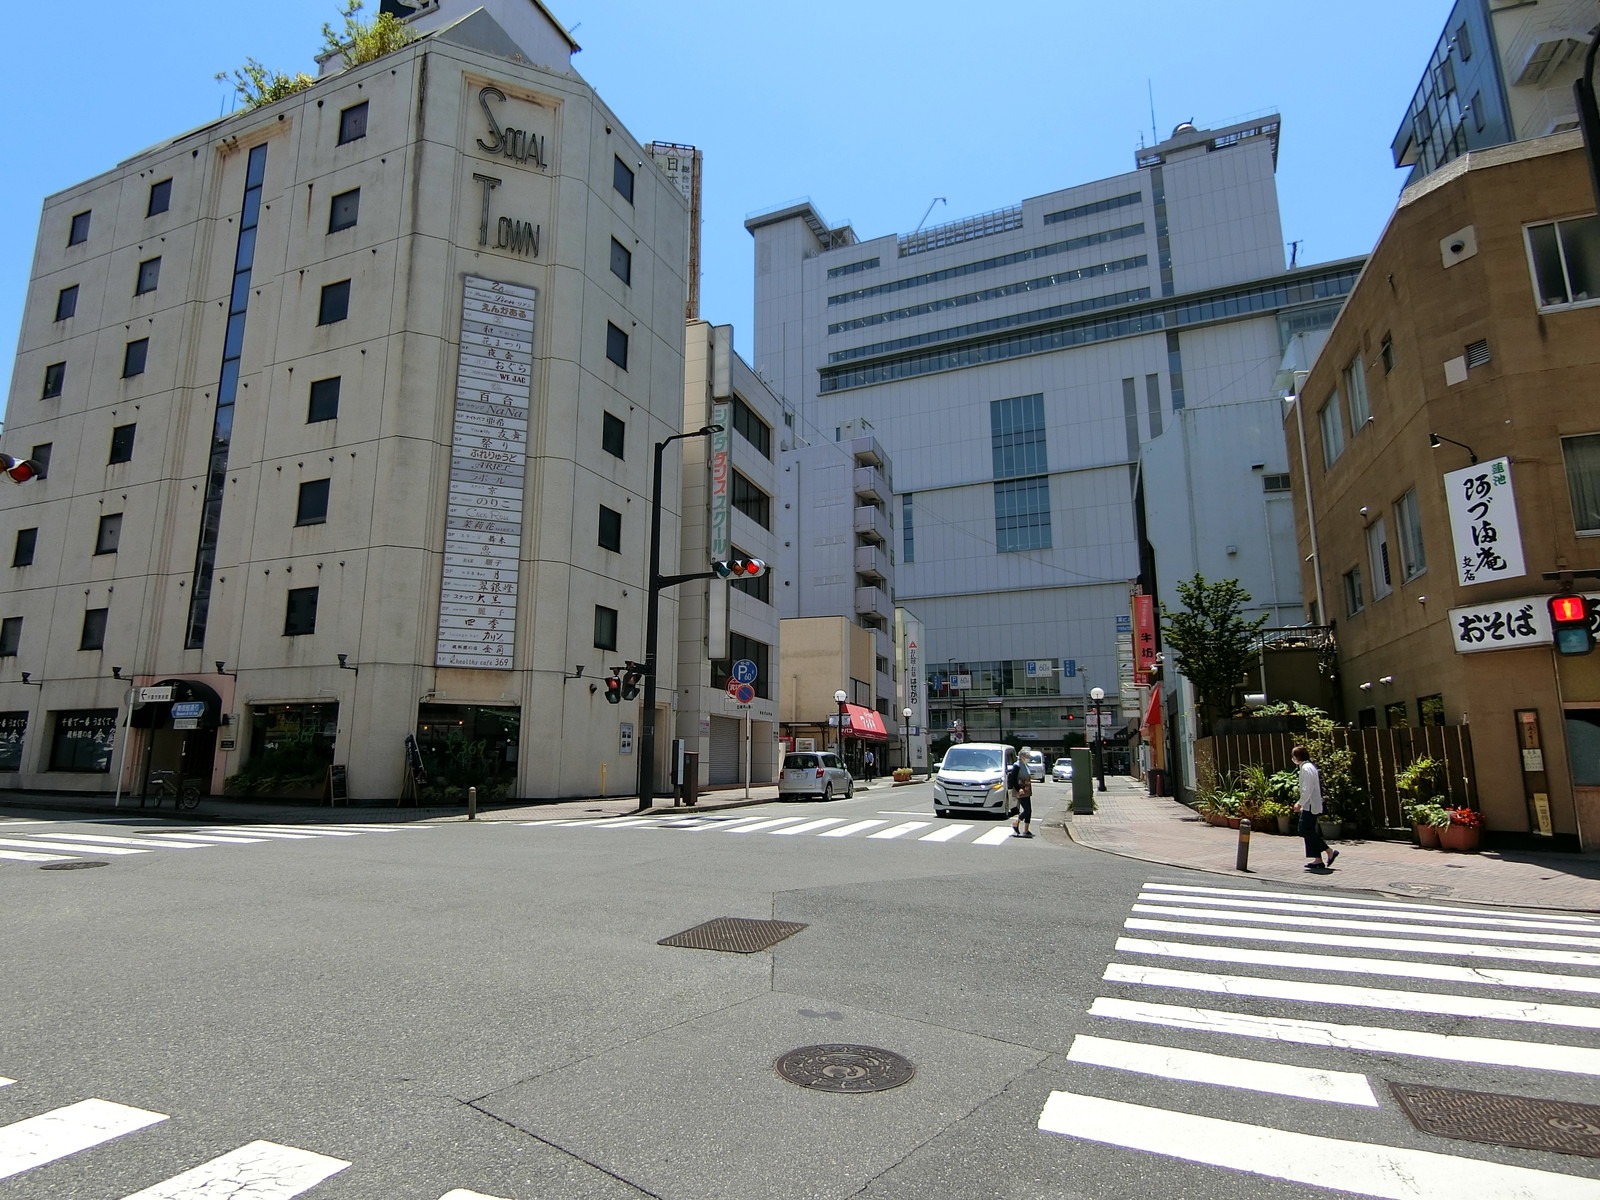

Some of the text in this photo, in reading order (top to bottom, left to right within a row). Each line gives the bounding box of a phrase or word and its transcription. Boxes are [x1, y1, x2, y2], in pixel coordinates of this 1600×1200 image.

[476, 86, 548, 168] SOCIAL
[473, 172, 541, 258] TOWN
[495, 360, 526, 373] おぐら
[479, 392, 514, 405] 百合
[476, 497, 510, 509] のりこ
[1458, 604, 1538, 643] おそば
[494, 658, 509, 666] 369
[738, 665, 752, 681] P 60
[910, 678, 918, 704] はせがわ
